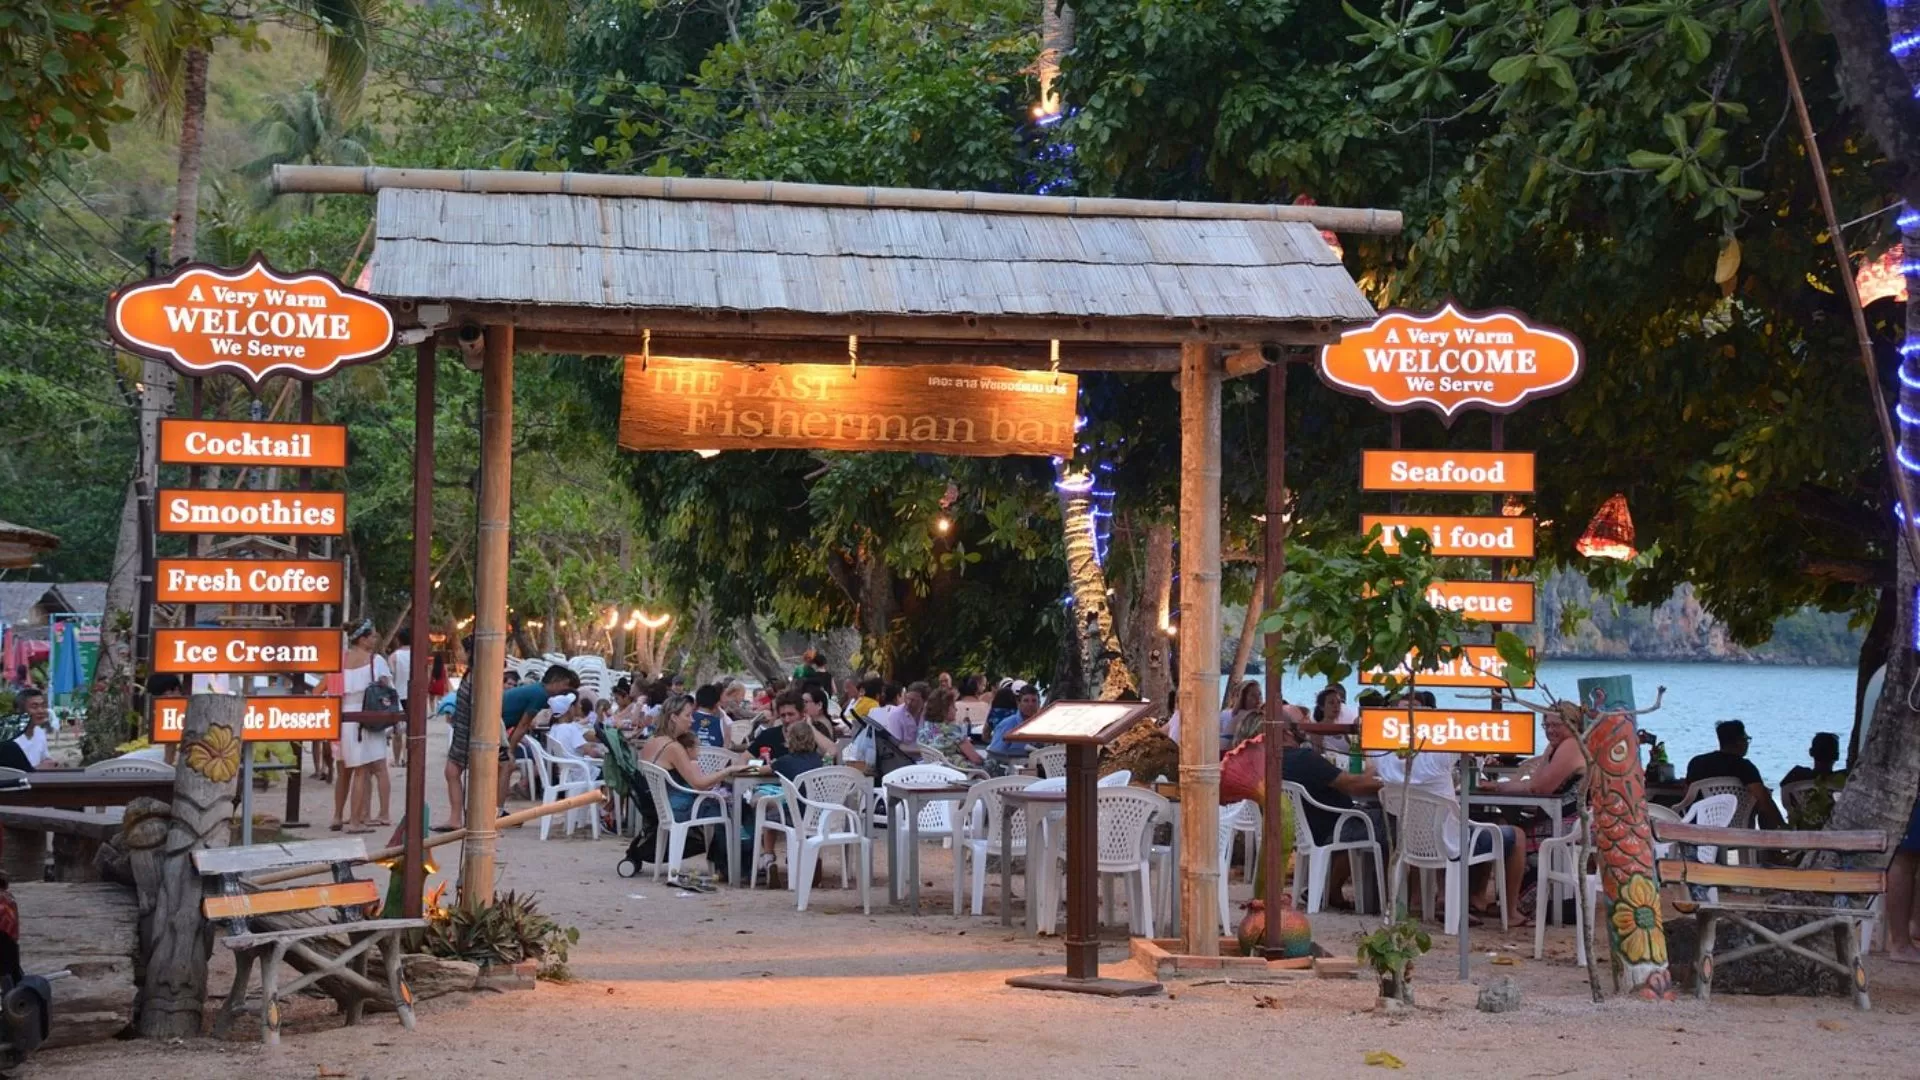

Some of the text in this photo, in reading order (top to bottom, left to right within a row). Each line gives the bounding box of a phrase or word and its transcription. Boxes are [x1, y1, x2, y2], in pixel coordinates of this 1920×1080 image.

[188, 285, 327, 308] A Very Warm
[164, 306, 350, 340] WELCOME
[210, 338, 305, 358] We Serve
[1385, 328, 1514, 347] A Very Warm
[1364, 349, 1537, 374] WELCOME
[649, 368, 837, 400] THE LAST
[1405, 376, 1494, 392] We Serve
[683, 398, 1073, 445] Fisherman bar
[184, 432, 312, 457] Cocktail
[1390, 461, 1505, 483] Seafood
[169, 499, 336, 525] Smoothies
[1382, 525, 1515, 548] Ti food
[167, 568, 330, 592] Fresh Coffee
[1425, 588, 1513, 612] becue
[173, 640, 319, 663] Ice Cream
[268, 706, 332, 729] Dessert
[1382, 717, 1512, 745] Spaghetti
